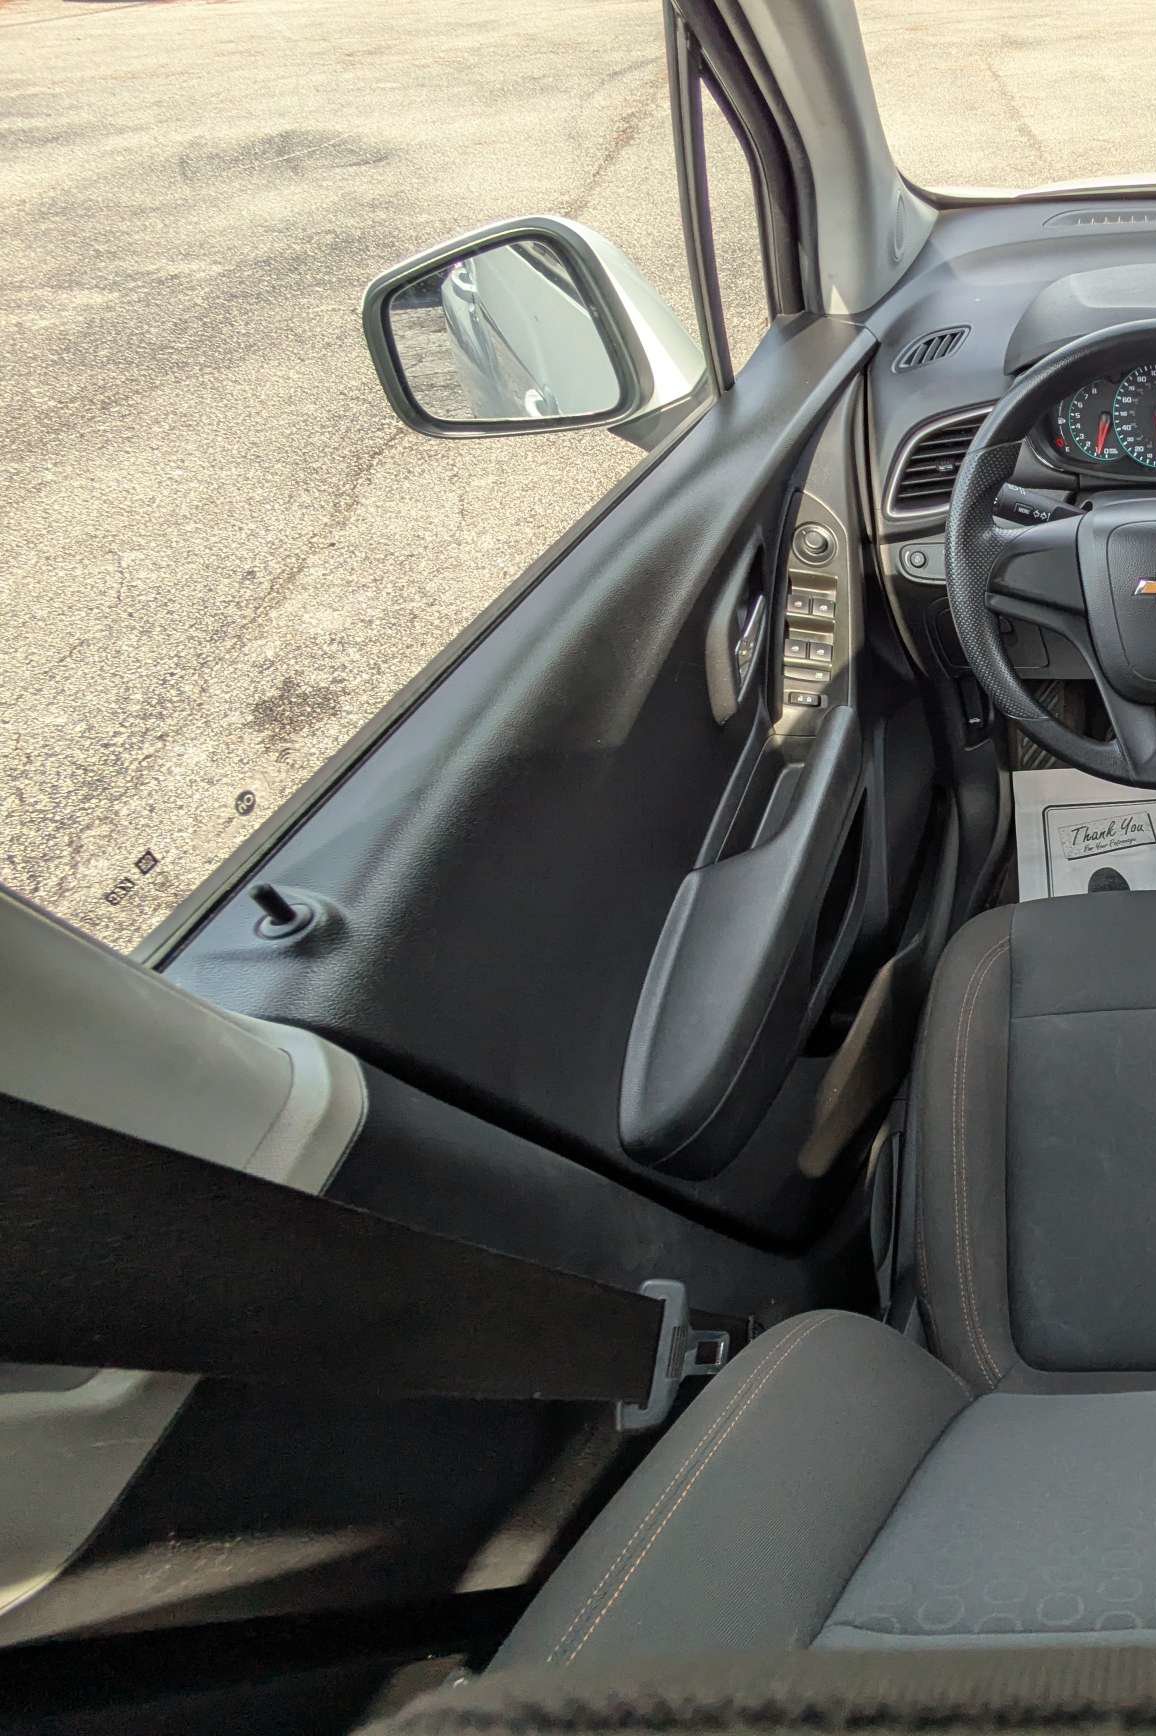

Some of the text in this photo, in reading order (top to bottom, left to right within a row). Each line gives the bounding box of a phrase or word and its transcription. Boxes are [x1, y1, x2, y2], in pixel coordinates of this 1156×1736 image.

[1072, 816, 1144, 846] Thank You
[1096, 842, 1108, 851] Your
